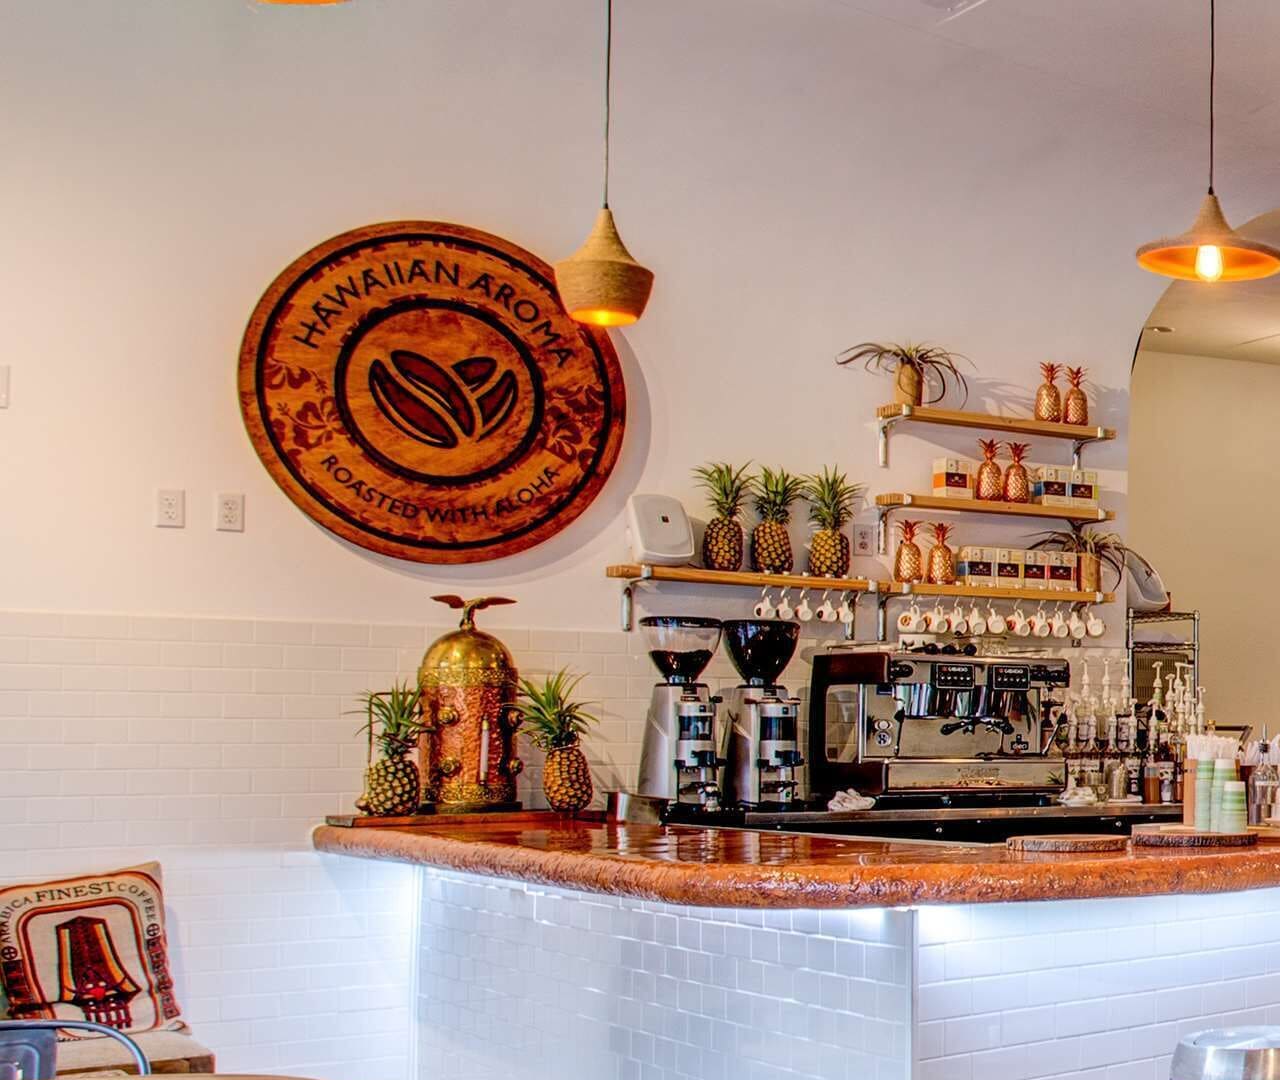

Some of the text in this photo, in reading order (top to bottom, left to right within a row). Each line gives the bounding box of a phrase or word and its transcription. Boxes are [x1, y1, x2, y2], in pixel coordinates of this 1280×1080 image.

[292, 259, 577, 368] HAWAIIAN AROMA
[320, 455, 561, 524] ROASTED WITH ALOHA
[34, 880, 118, 902] FINEST
[118, 883, 156, 924] COFFEE
